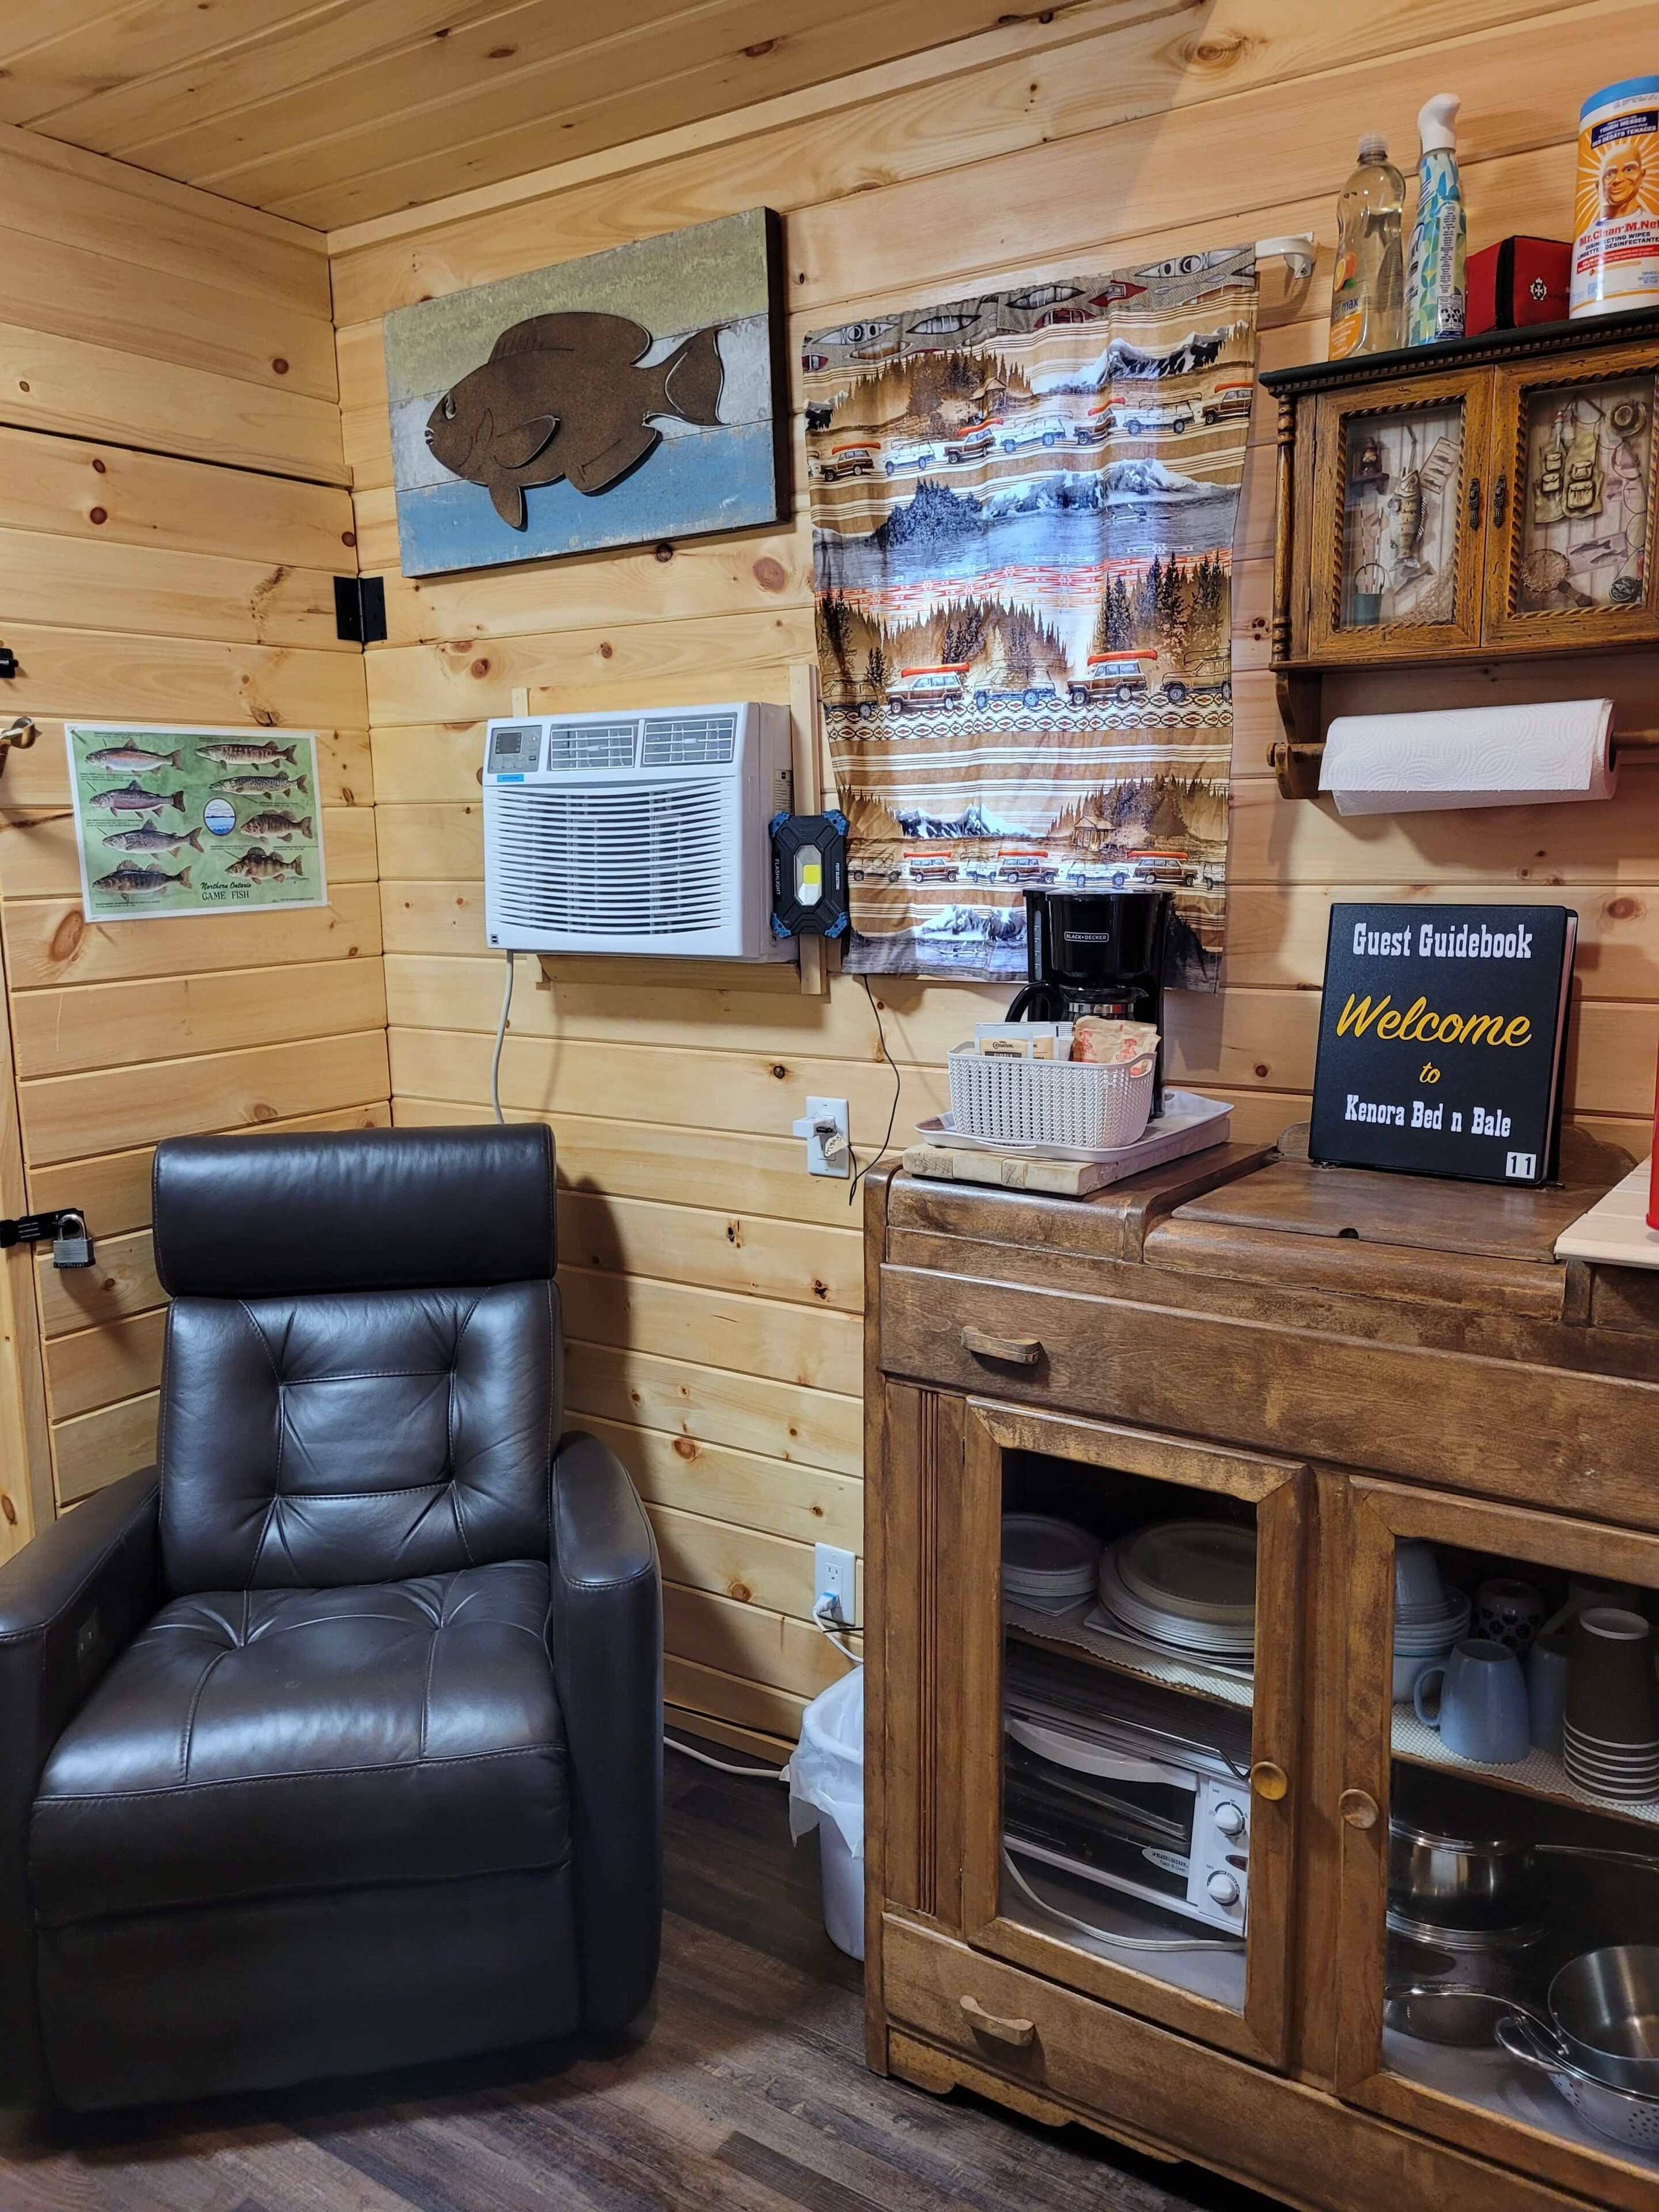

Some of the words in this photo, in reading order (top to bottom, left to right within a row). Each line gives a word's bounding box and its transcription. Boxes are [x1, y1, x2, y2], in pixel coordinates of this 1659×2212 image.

[1600, 122, 1619, 134] TOUGH
[1586, 234, 1627, 251] DISINCTING
[1628, 231, 1650, 239] WIPES
[1605, 237, 1659, 249] DÉSINFECTANTE
[1342, 297, 1358, 311] max
[200, 882, 228, 890] Northern
[230, 881, 252, 889] Ontario
[202, 891, 226, 900] GAME
[232, 891, 249, 899] FISH
[1353, 922, 1411, 958] Guest
[1419, 924, 1532, 959] Guidebook
[1336, 993, 1532, 1047] Welcome
[1419, 1061, 1441, 1084] to
[1344, 1094, 1405, 1126] Kenora
[1411, 1101, 1444, 1132] Bed
[1450, 1111, 1463, 1132] n
[1471, 1107, 1512, 1138] Bale
